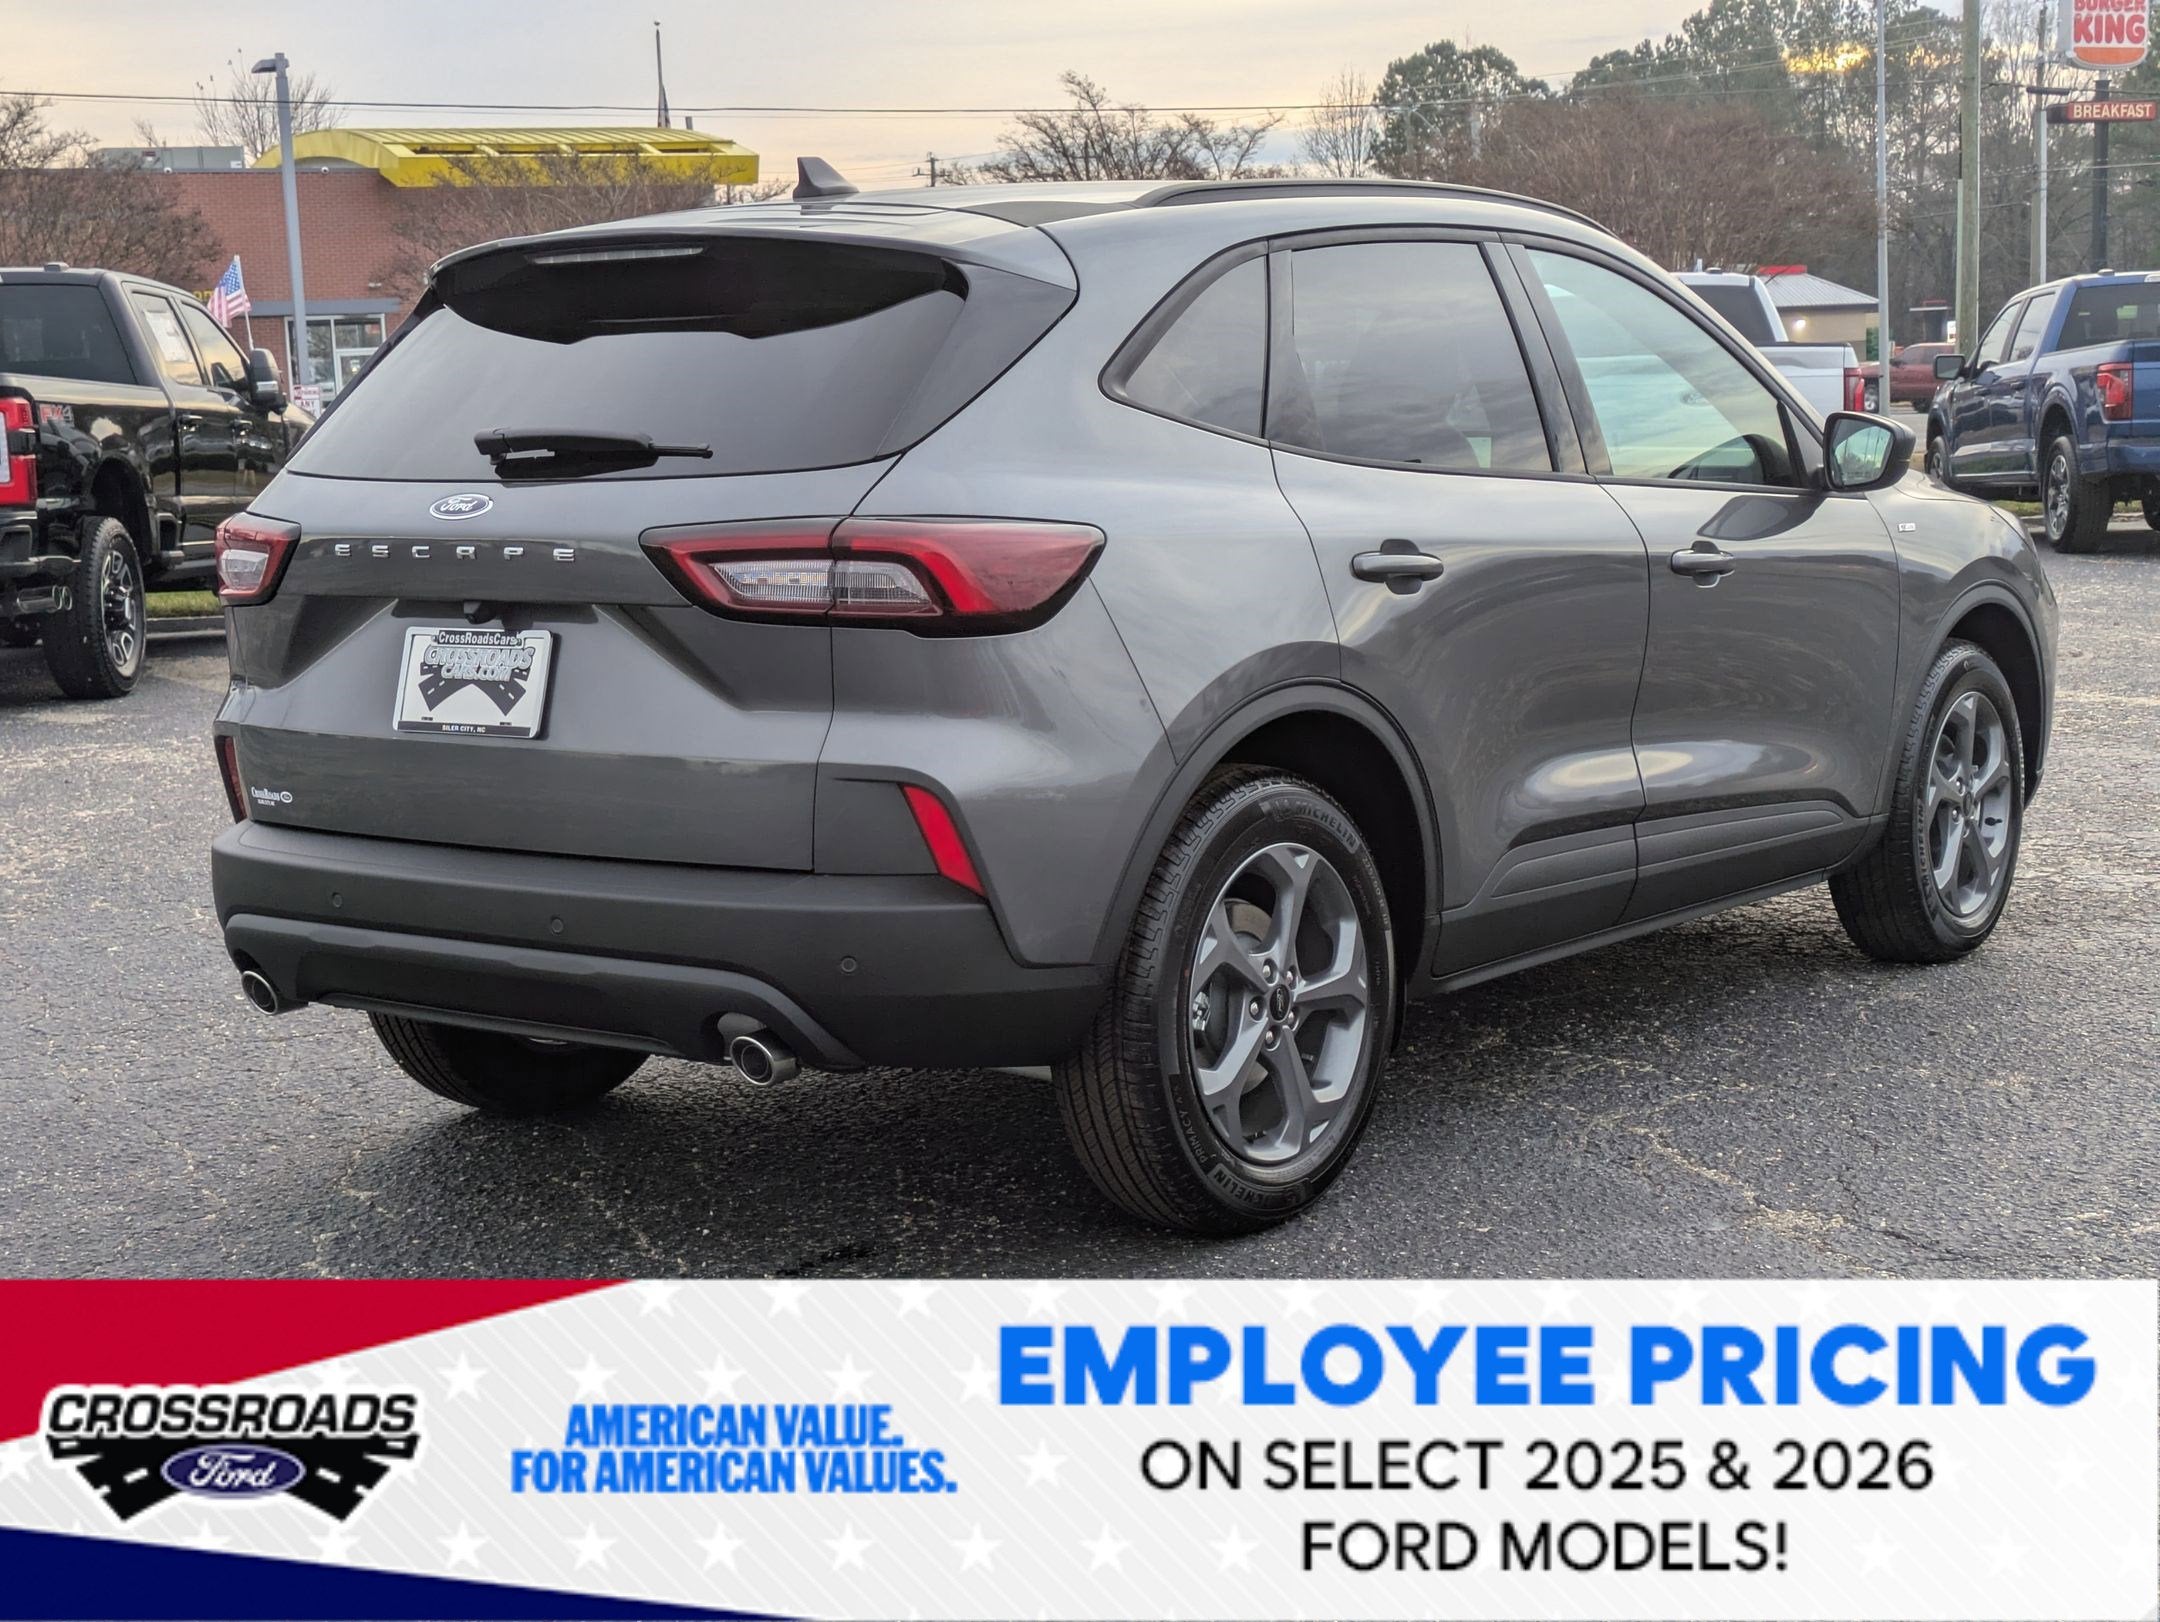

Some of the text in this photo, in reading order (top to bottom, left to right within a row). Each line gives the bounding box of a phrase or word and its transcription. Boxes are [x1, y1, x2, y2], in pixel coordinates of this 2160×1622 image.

[2074, 13, 2146, 44] KING
[2073, 104, 2153, 119] BREAKFAST
[40, 404, 75, 427] FX4
[440, 497, 478, 511] Ford
[334, 543, 576, 562] ESCAPE
[1178, 1111, 1208, 1164] PRIMACY
